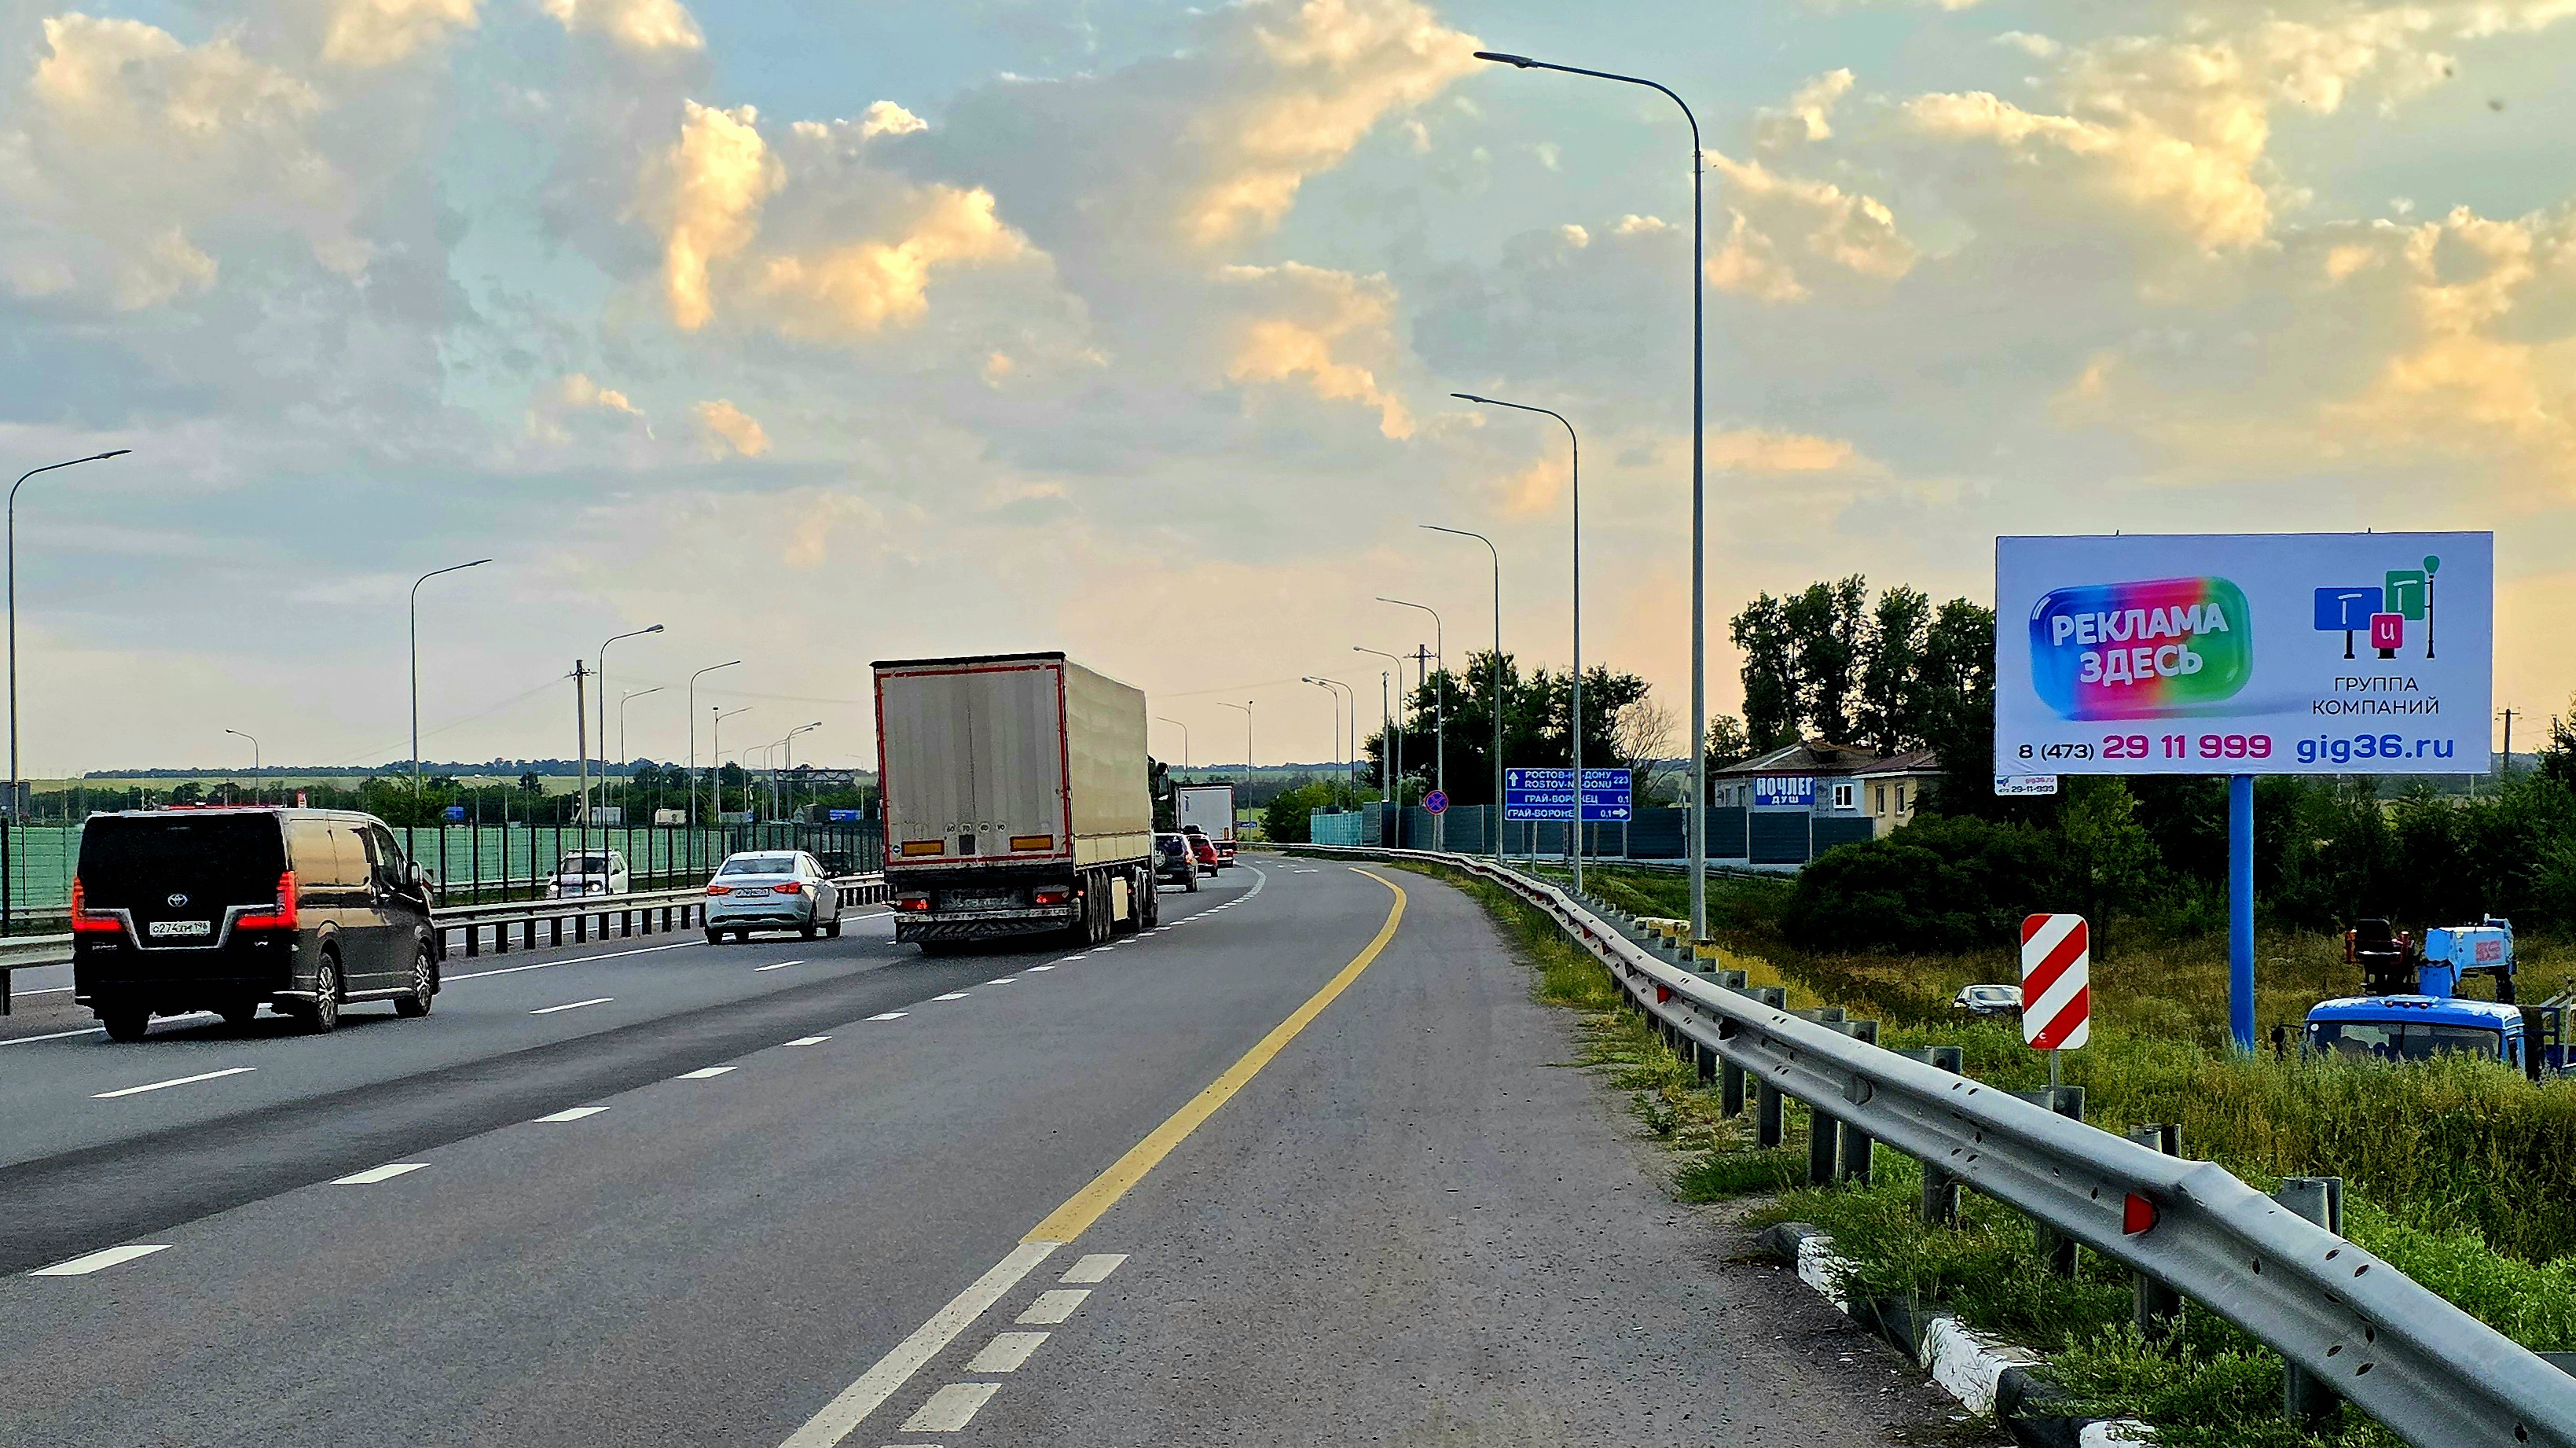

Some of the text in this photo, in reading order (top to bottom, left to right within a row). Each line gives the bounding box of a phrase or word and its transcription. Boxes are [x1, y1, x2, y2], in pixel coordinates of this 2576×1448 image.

[2052, 602, 2229, 646] РЕКЛАМА
[2079, 644, 2204, 687] ЗДЕСЬ
[2334, 676, 2420, 692] ГРУППА
[2313, 696, 2439, 715] КОМПАНИЙ
[2018, 734, 2272, 762] 8 (473) 29 11 999
[2296, 734, 2453, 764] gig36.ru
[1525, 770, 1612, 780] РОСТОВ-Н-ДОНУ
[1613, 776, 1629, 785] 223
[1525, 780, 1612, 788] ROSTOV-N-DONU
[1756, 777, 1814, 796] НОЧЛЕГ
[1771, 796, 1800, 804] ДУШ
[1507, 808, 1575, 818] ГРАЙ-ВОРОНЕ
